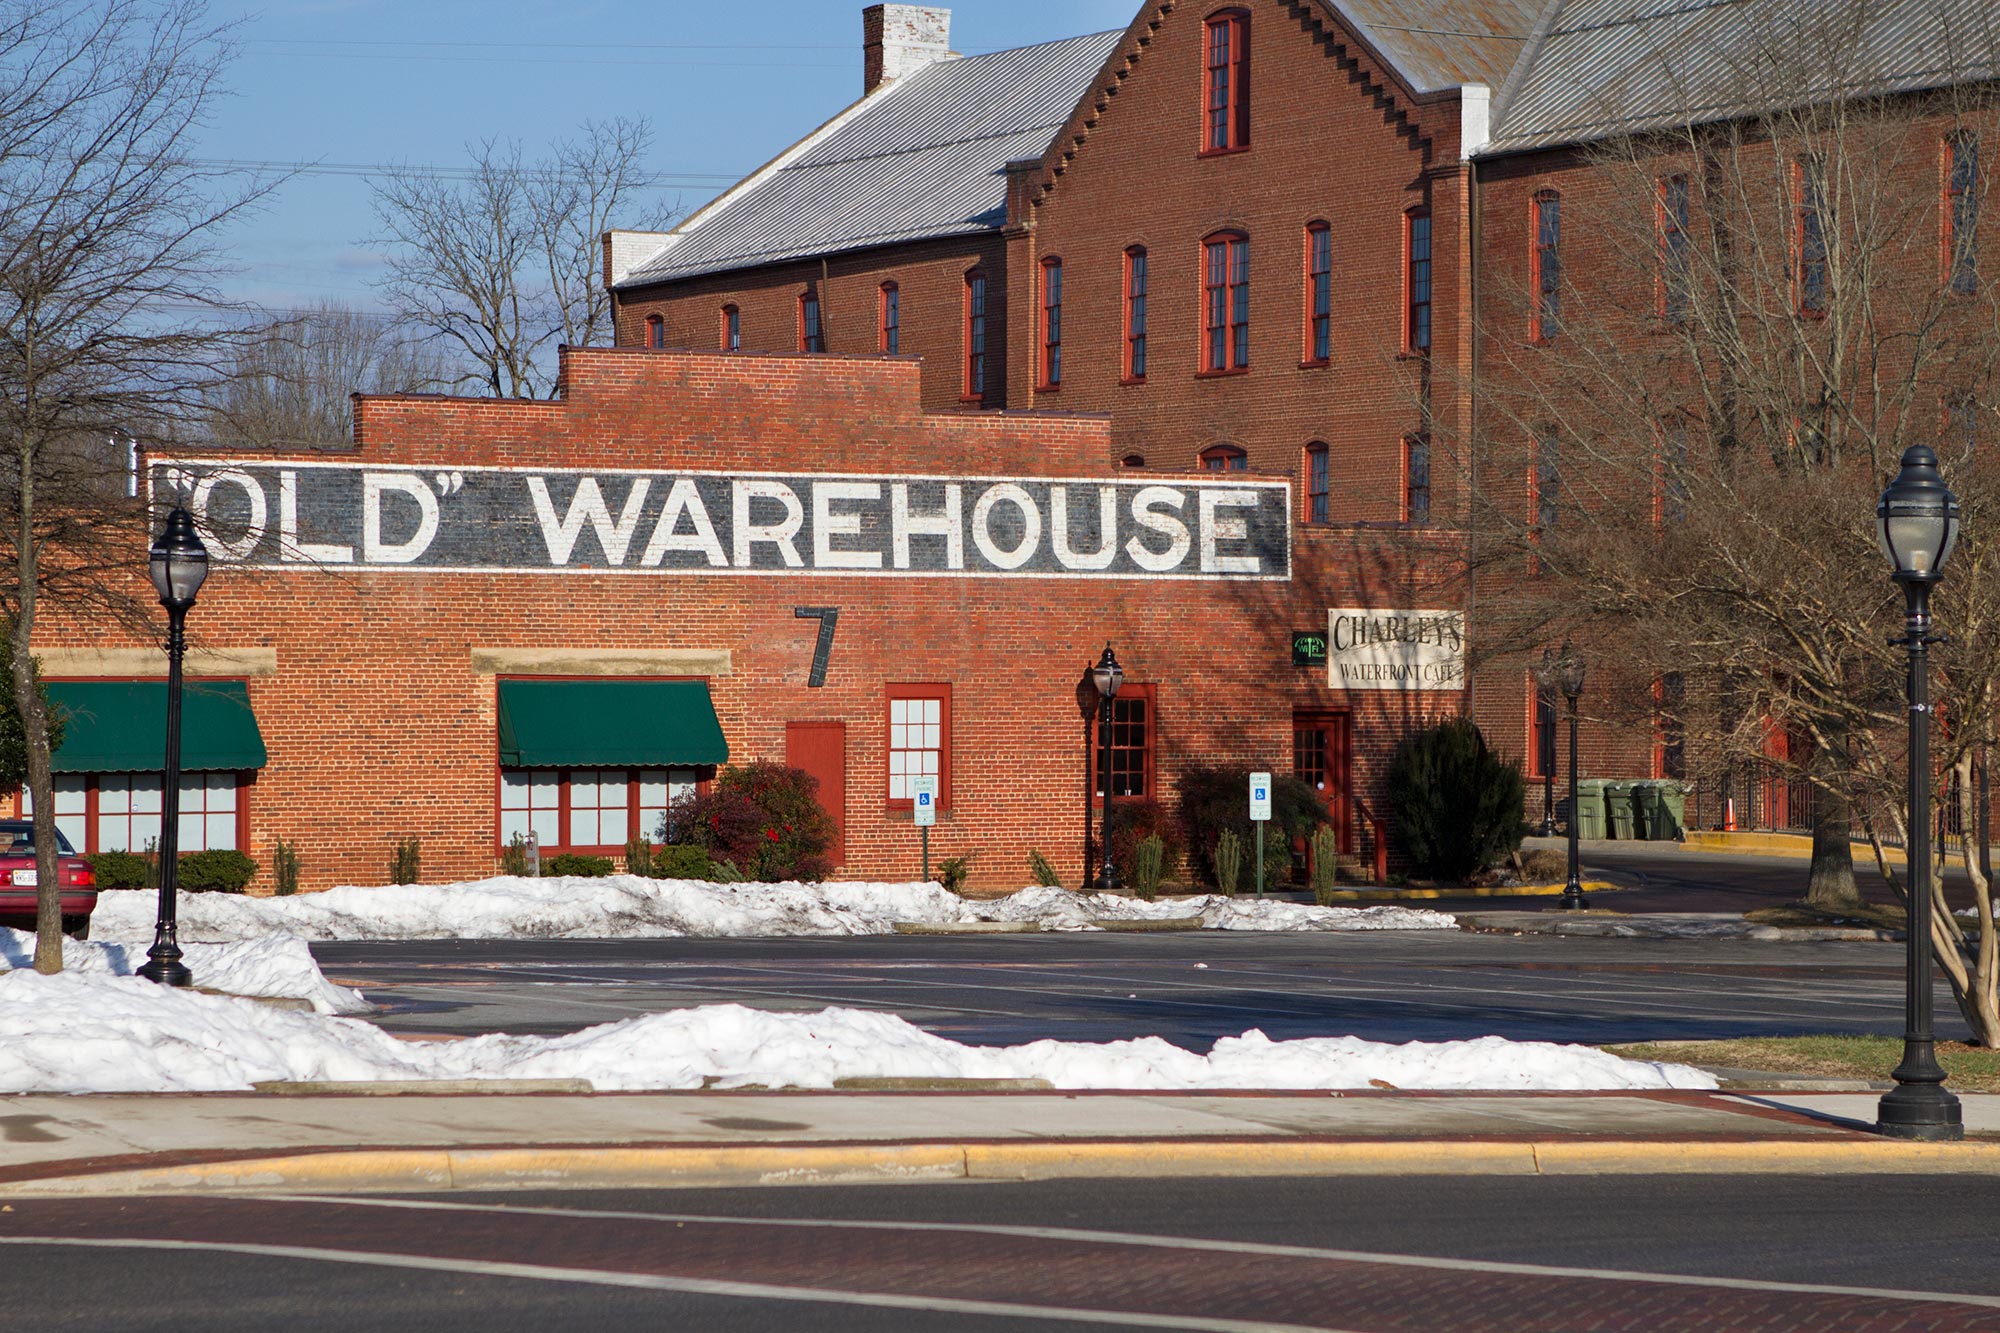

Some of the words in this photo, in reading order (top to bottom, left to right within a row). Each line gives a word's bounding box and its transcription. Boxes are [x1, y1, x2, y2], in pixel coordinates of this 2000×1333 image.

[526, 476, 1261, 573] WAREHOUSE
[795, 607, 838, 687] 7
[1340, 663, 1419, 681] WATERFRONT
